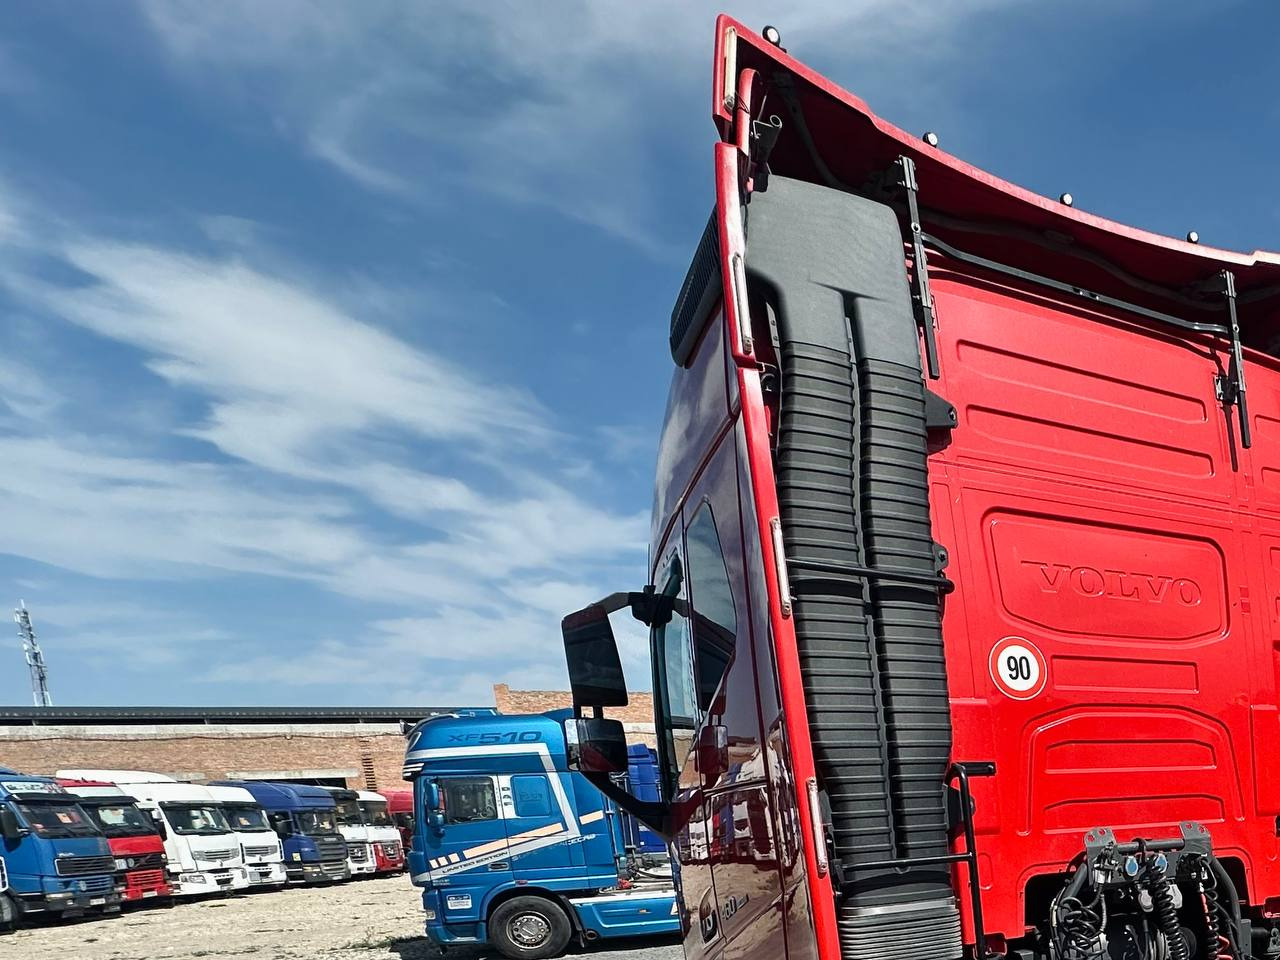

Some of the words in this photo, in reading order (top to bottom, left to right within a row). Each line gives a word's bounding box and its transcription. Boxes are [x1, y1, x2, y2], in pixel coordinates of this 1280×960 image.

[1020, 560, 1201, 606] VOLVO
[1007, 656, 1031, 680] 90
[448, 731, 542, 743] XF510
[442, 862, 475, 873] LIMITED
